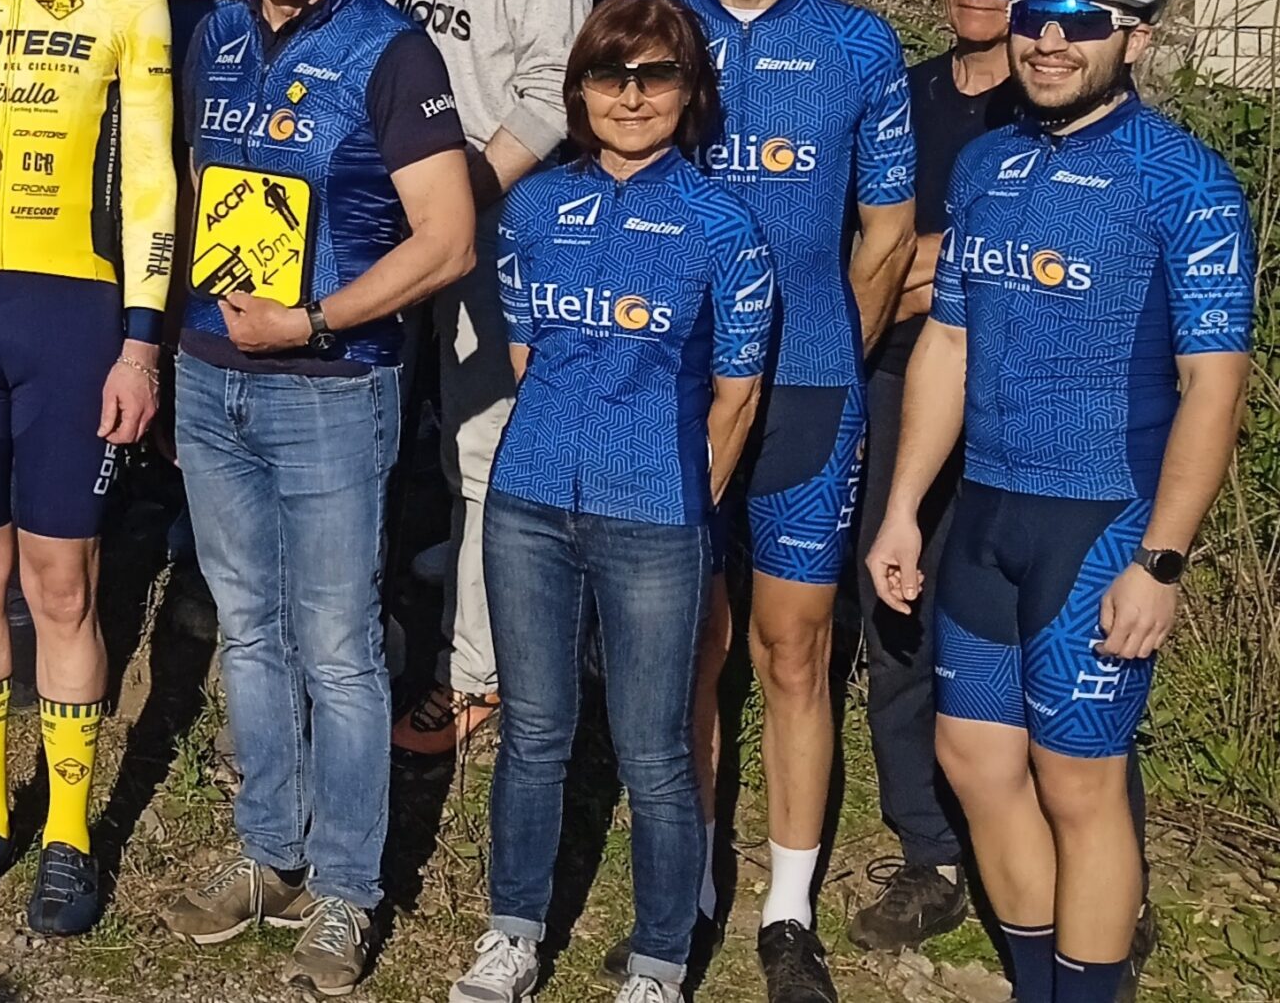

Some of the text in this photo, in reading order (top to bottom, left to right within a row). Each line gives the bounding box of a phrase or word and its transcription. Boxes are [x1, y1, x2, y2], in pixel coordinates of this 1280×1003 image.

[214, 54, 236, 65] ADR
[754, 57, 817, 72] Santini
[28, 62, 81, 75] CICLISTA
[293, 62, 343, 82] Santini
[200, 97, 316, 143] Helios
[876, 125, 904, 142] ADR
[997, 169, 1021, 180] ADR
[1049, 169, 1114, 190] Santini
[10, 206, 60, 216] LIFECODE
[206, 178, 255, 233] ACCPI
[557, 214, 585, 226] ADR
[1185, 204, 1241, 224] nrc
[623, 216, 687, 236] Santini
[960, 235, 1092, 291] Helios
[1184, 263, 1226, 277] ADR
[530, 282, 672, 333] Helios
[732, 299, 764, 314] ADR
[777, 535, 828, 551] Santini
